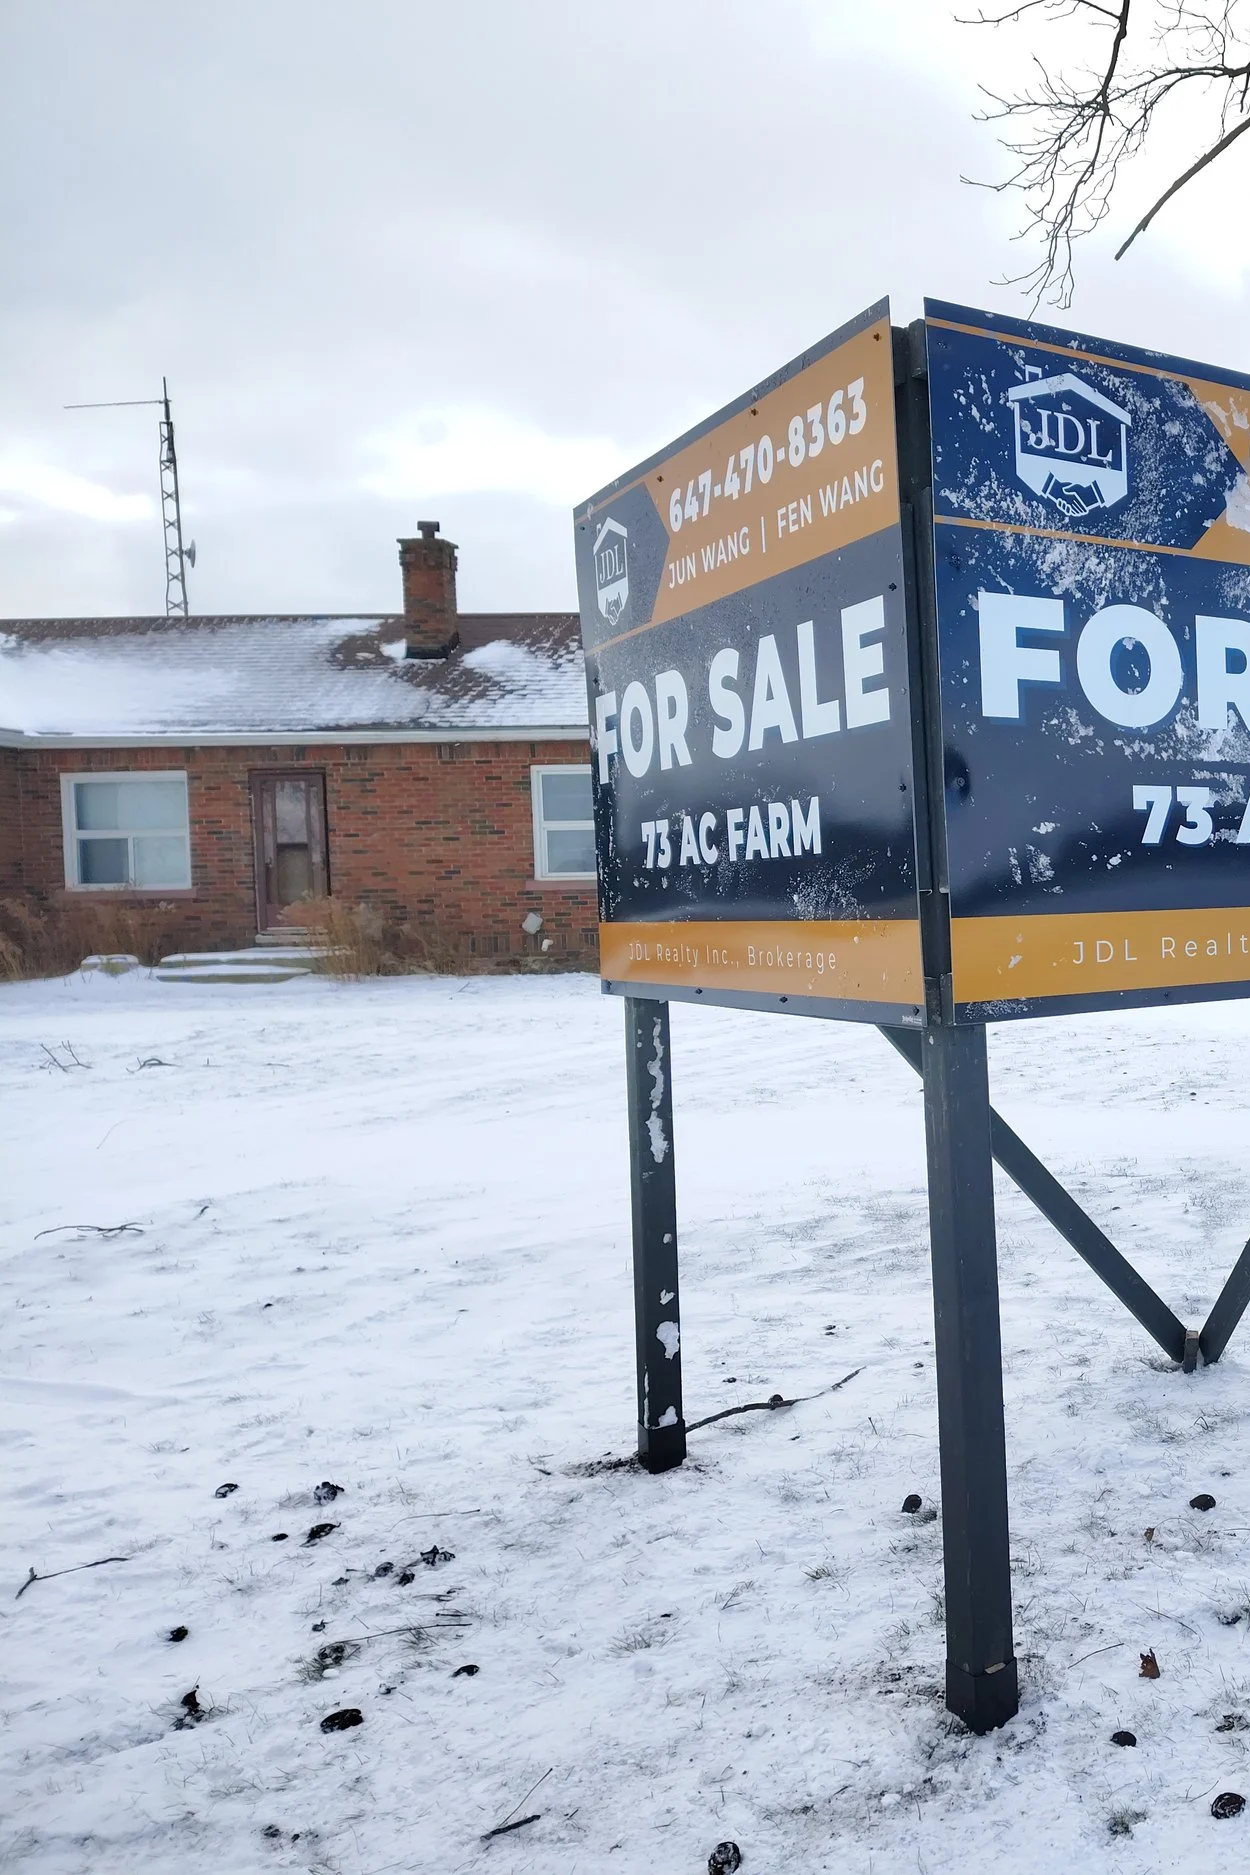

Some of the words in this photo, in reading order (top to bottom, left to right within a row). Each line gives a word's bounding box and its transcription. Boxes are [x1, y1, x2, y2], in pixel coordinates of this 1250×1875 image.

[669, 376, 867, 532] 647-470-8363
[1029, 408, 1113, 462] JDL
[668, 553, 697, 589] JUN
[701, 526, 750, 573] WANG
[776, 494, 812, 538] FEN
[818, 459, 884, 518] WANG
[599, 544, 624, 584] JDL
[595, 669, 693, 785] FOR
[708, 594, 891, 759] SALE
[641, 819, 671, 869] 73
[680, 811, 717, 866] AC
[726, 796, 822, 862] FARM
[1132, 784, 1215, 845] 73
[628, 942, 651, 961] JDL
[656, 943, 699, 968] Realty
[706, 945, 740, 969] Inc.,
[748, 945, 837, 975] Brokerage
[1072, 939, 1138, 965] JDL
